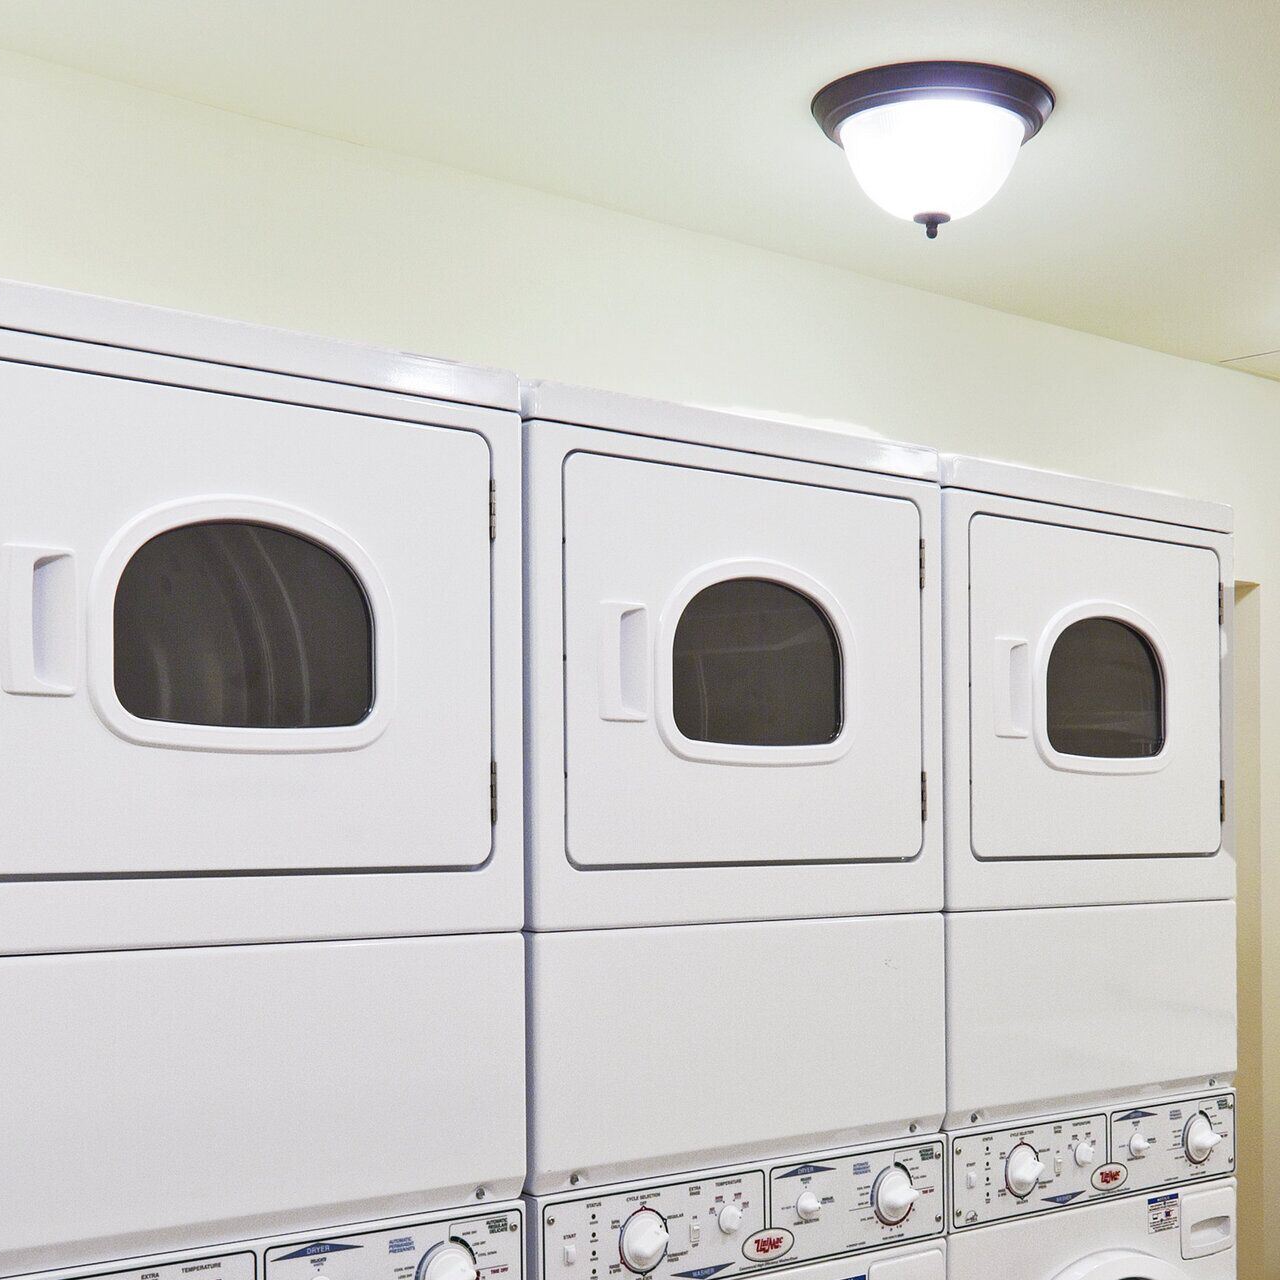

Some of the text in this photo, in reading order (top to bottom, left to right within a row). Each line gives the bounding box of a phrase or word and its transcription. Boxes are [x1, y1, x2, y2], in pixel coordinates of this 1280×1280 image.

[797, 1167, 814, 1175] DRYER
[715, 1179, 741, 1187] TEMPERATURE
[640, 1192, 661, 1200] SELECTION
[754, 1237, 783, 1253] UniMac
[307, 1245, 330, 1254] DRYER
[182, 1262, 221, 1274] TEMPERATURE
[141, 1272, 160, 1280] EXTRA
[692, 1268, 715, 1277] WASHER
